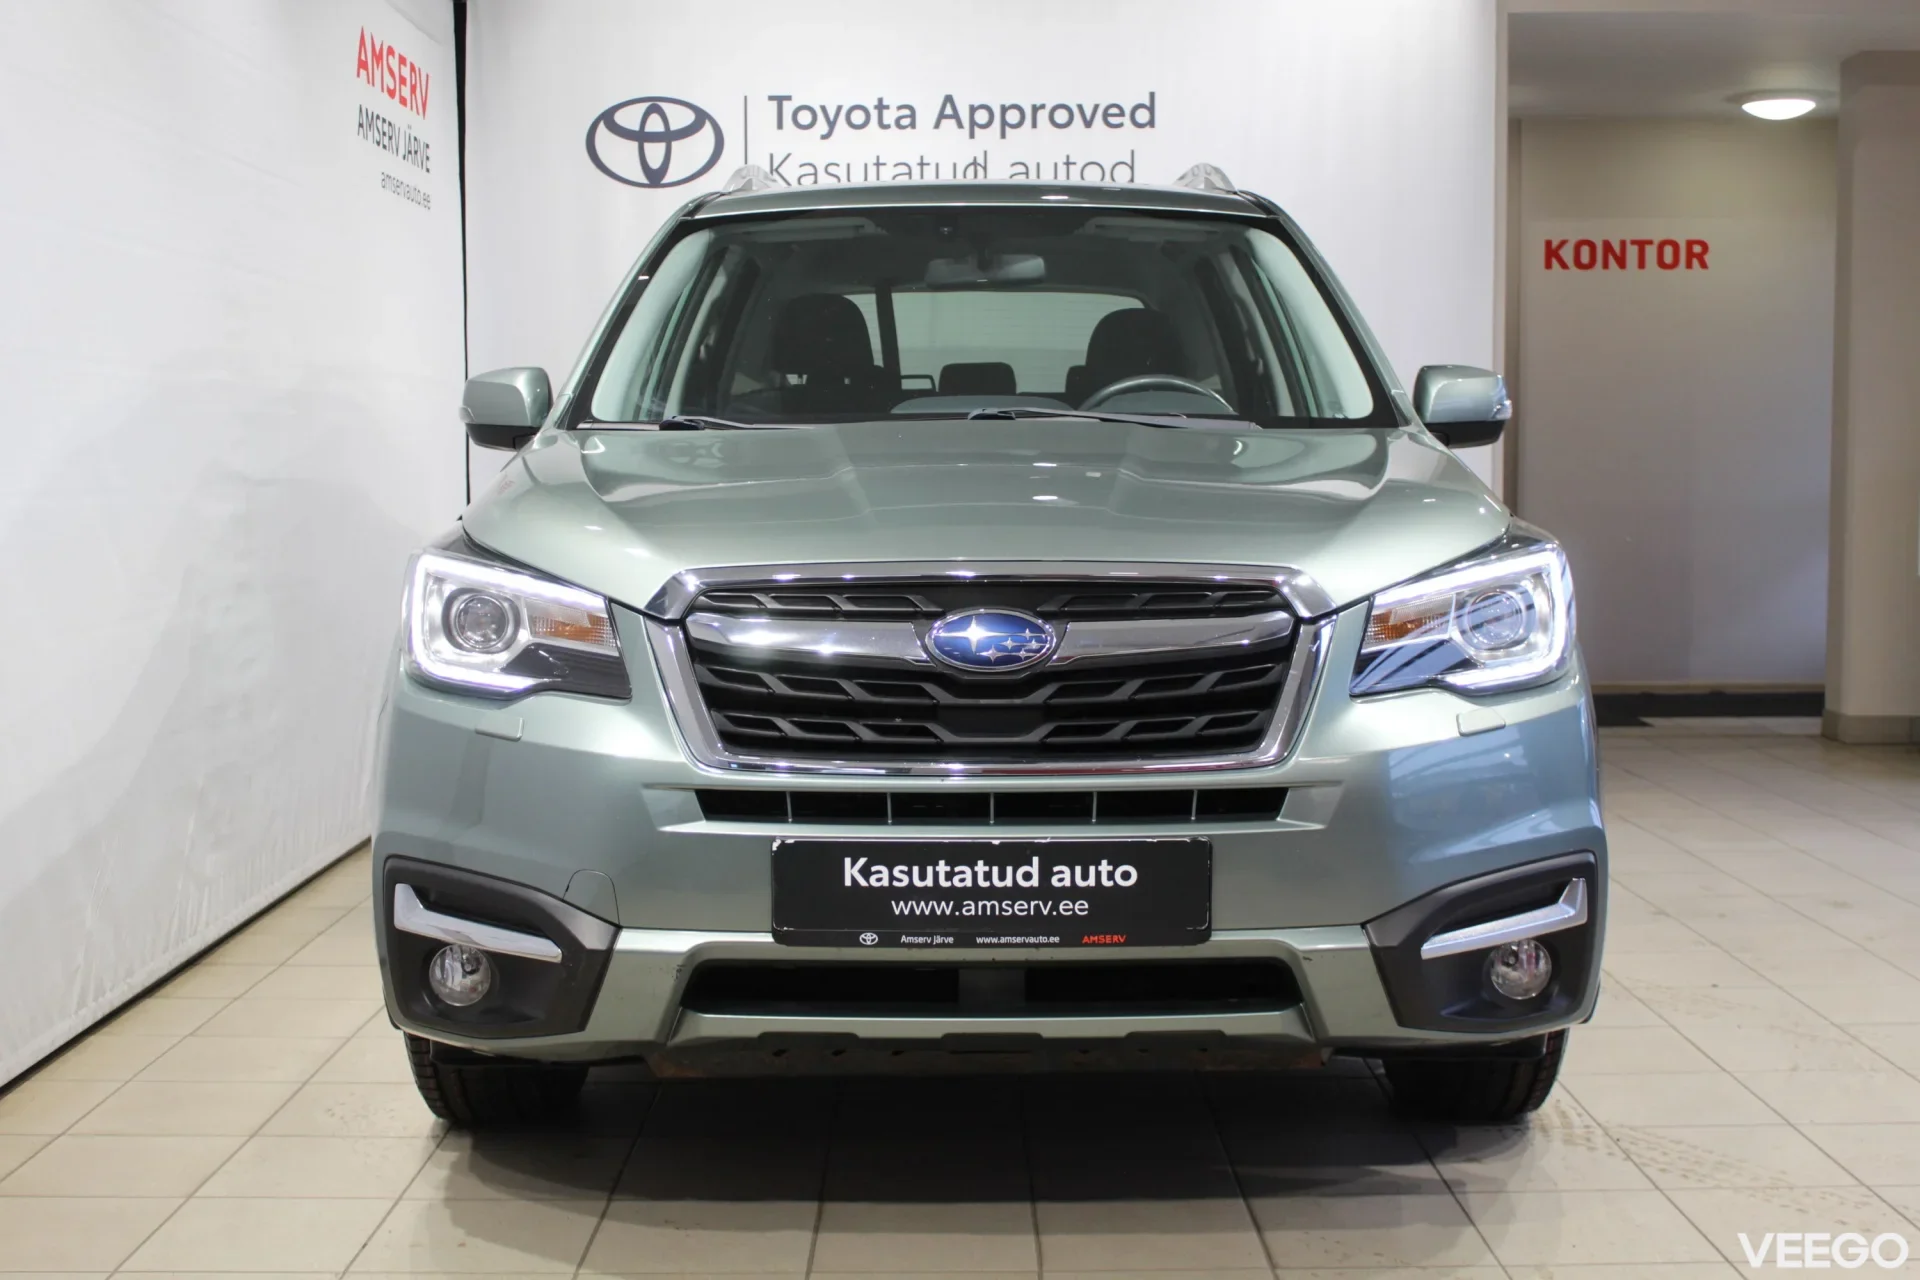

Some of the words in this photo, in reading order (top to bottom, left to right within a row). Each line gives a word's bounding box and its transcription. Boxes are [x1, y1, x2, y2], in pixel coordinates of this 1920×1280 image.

[356, 25, 430, 120] AMSERV
[767, 93, 918, 140] Toyota
[933, 92, 1157, 140] Approved
[357, 104, 401, 157] AMSERV
[402, 123, 430, 173] JÄRVE
[768, 150, 988, 187] Kasutatud
[1009, 149, 1135, 183] autod
[381, 170, 431, 210] amservauto.ee
[1543, 239, 1710, 270] KONTOR
[843, 856, 1040, 888] Kasutatud
[1051, 858, 1138, 888] auto
[891, 899, 1089, 916] www.amserv.ee
[900, 935, 932, 944] Amserv
[933, 935, 954, 945] Järve
[976, 935, 1060, 944] www.amservauto.ee
[1082, 935, 1127, 944] AMSERV
